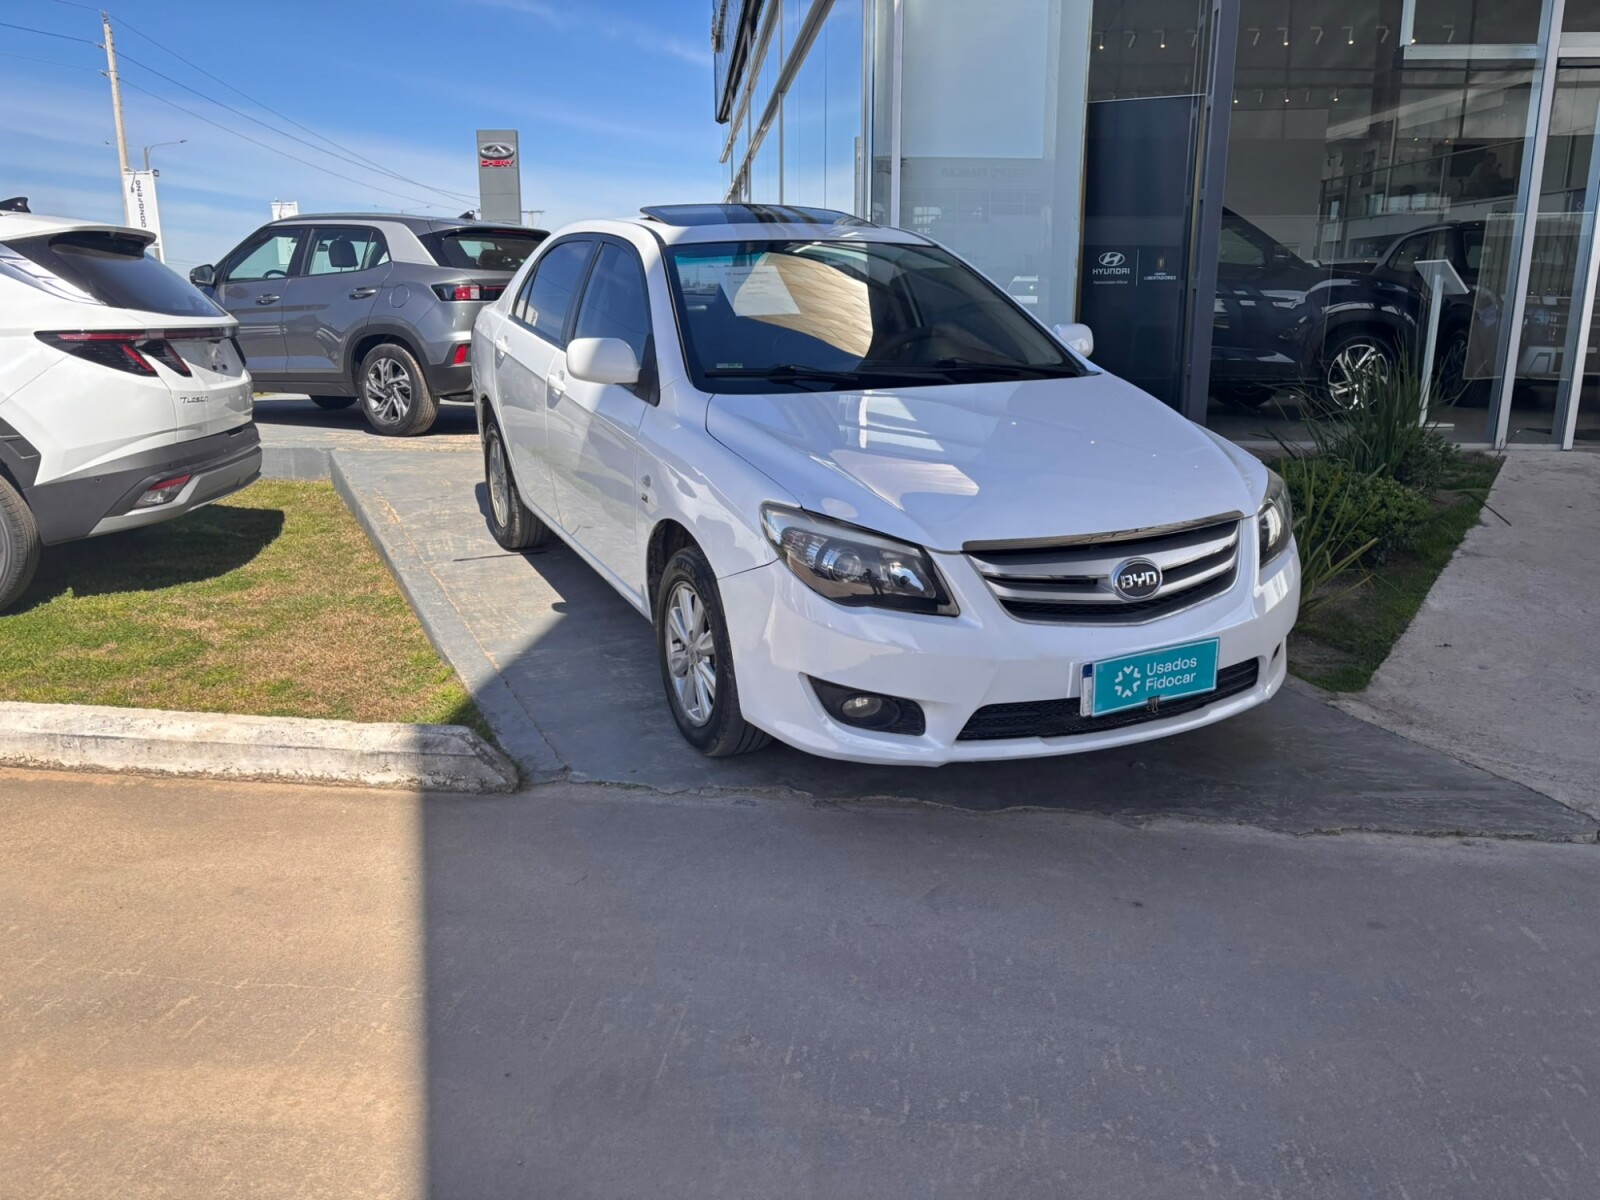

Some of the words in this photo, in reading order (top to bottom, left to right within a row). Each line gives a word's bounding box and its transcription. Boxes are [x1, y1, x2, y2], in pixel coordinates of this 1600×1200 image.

[135, 180, 147, 228] DONGFENG
[1092, 267, 1130, 275] HYUNDAI
[1120, 571, 1157, 589] BYD
[1146, 656, 1198, 676] Usados
[1145, 672, 1197, 691] Fidocar
